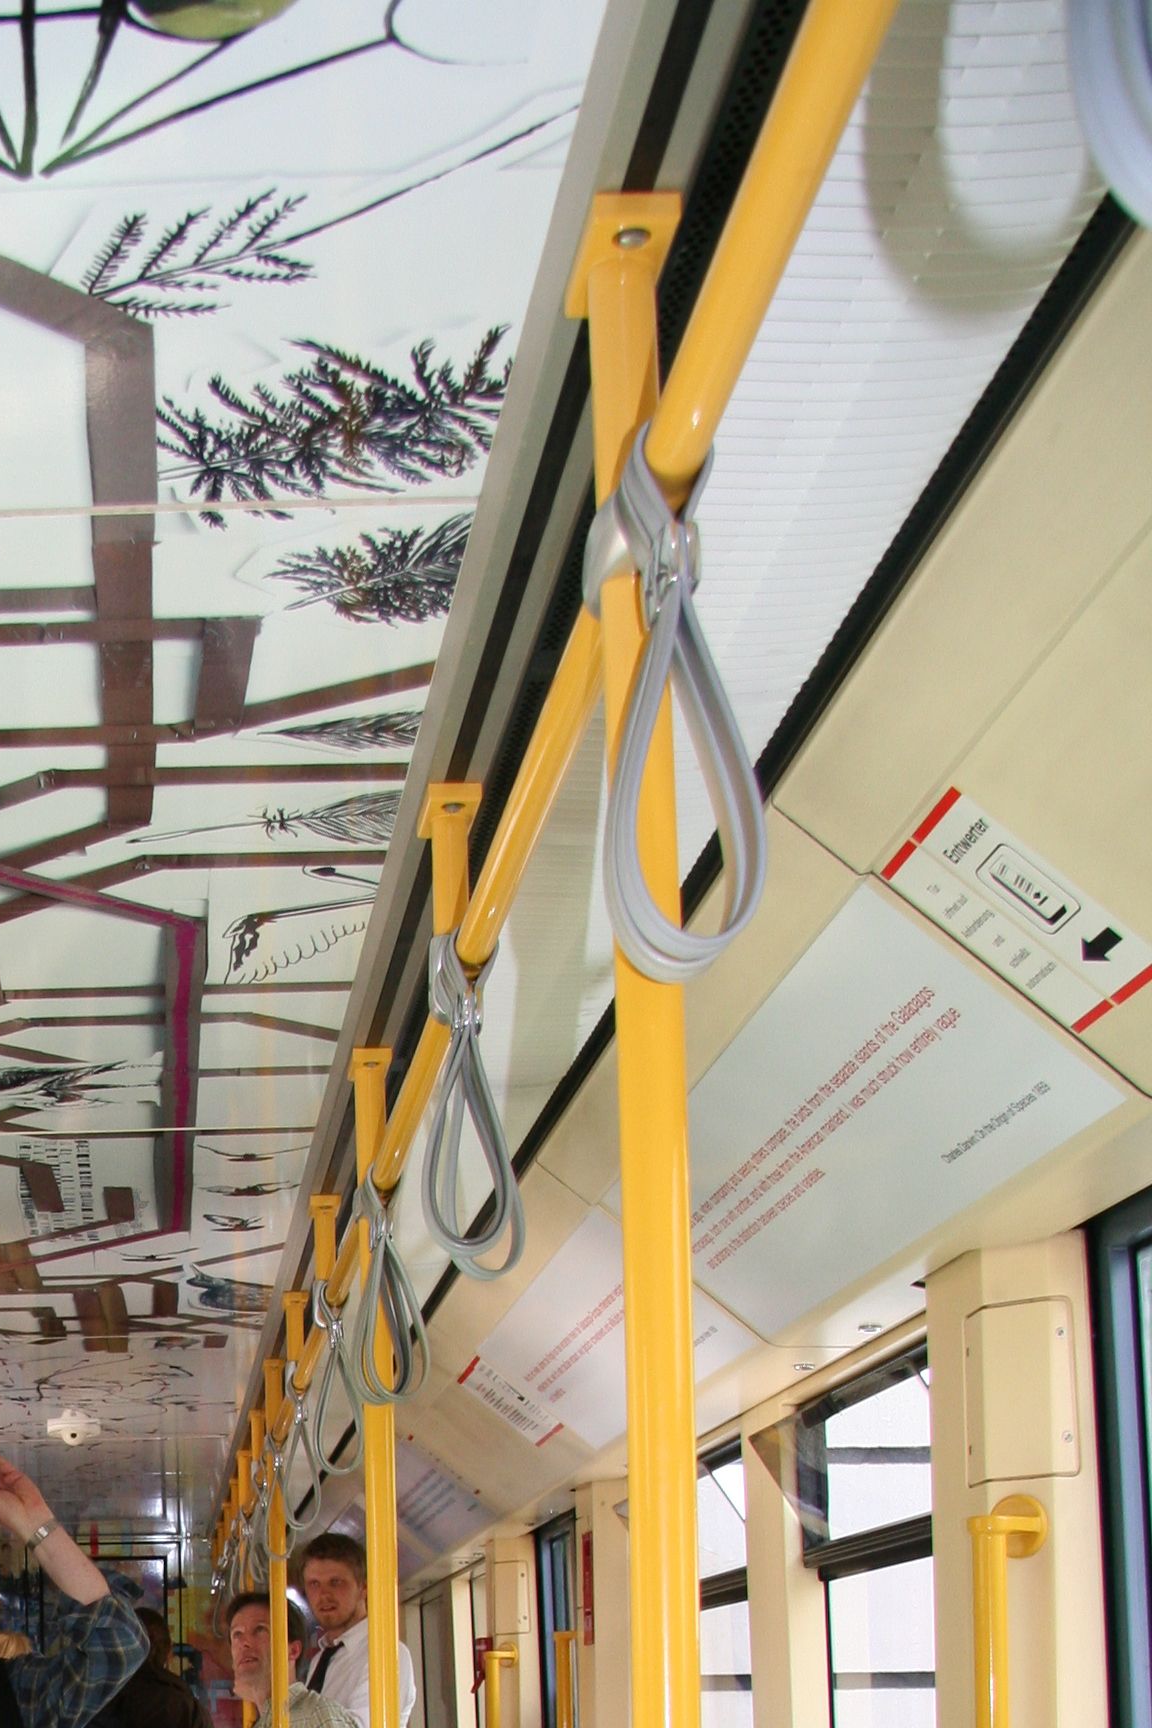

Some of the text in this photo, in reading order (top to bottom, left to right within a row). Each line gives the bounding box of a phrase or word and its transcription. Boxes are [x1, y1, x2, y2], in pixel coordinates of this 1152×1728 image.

[942, 818, 989, 864] Entwerter
[890, 985, 936, 1025] Galapagos
[873, 1027, 888, 1044] of
[879, 1021, 900, 1037] the
[850, 1039, 881, 1065] islands
[859, 1078, 884, 1102] much
[876, 1060, 903, 1085] struck
[891, 1048, 916, 1069] how
[910, 1026, 943, 1054] entirely
[932, 1007, 961, 1032] vague
[828, 1060, 860, 1089] separate
